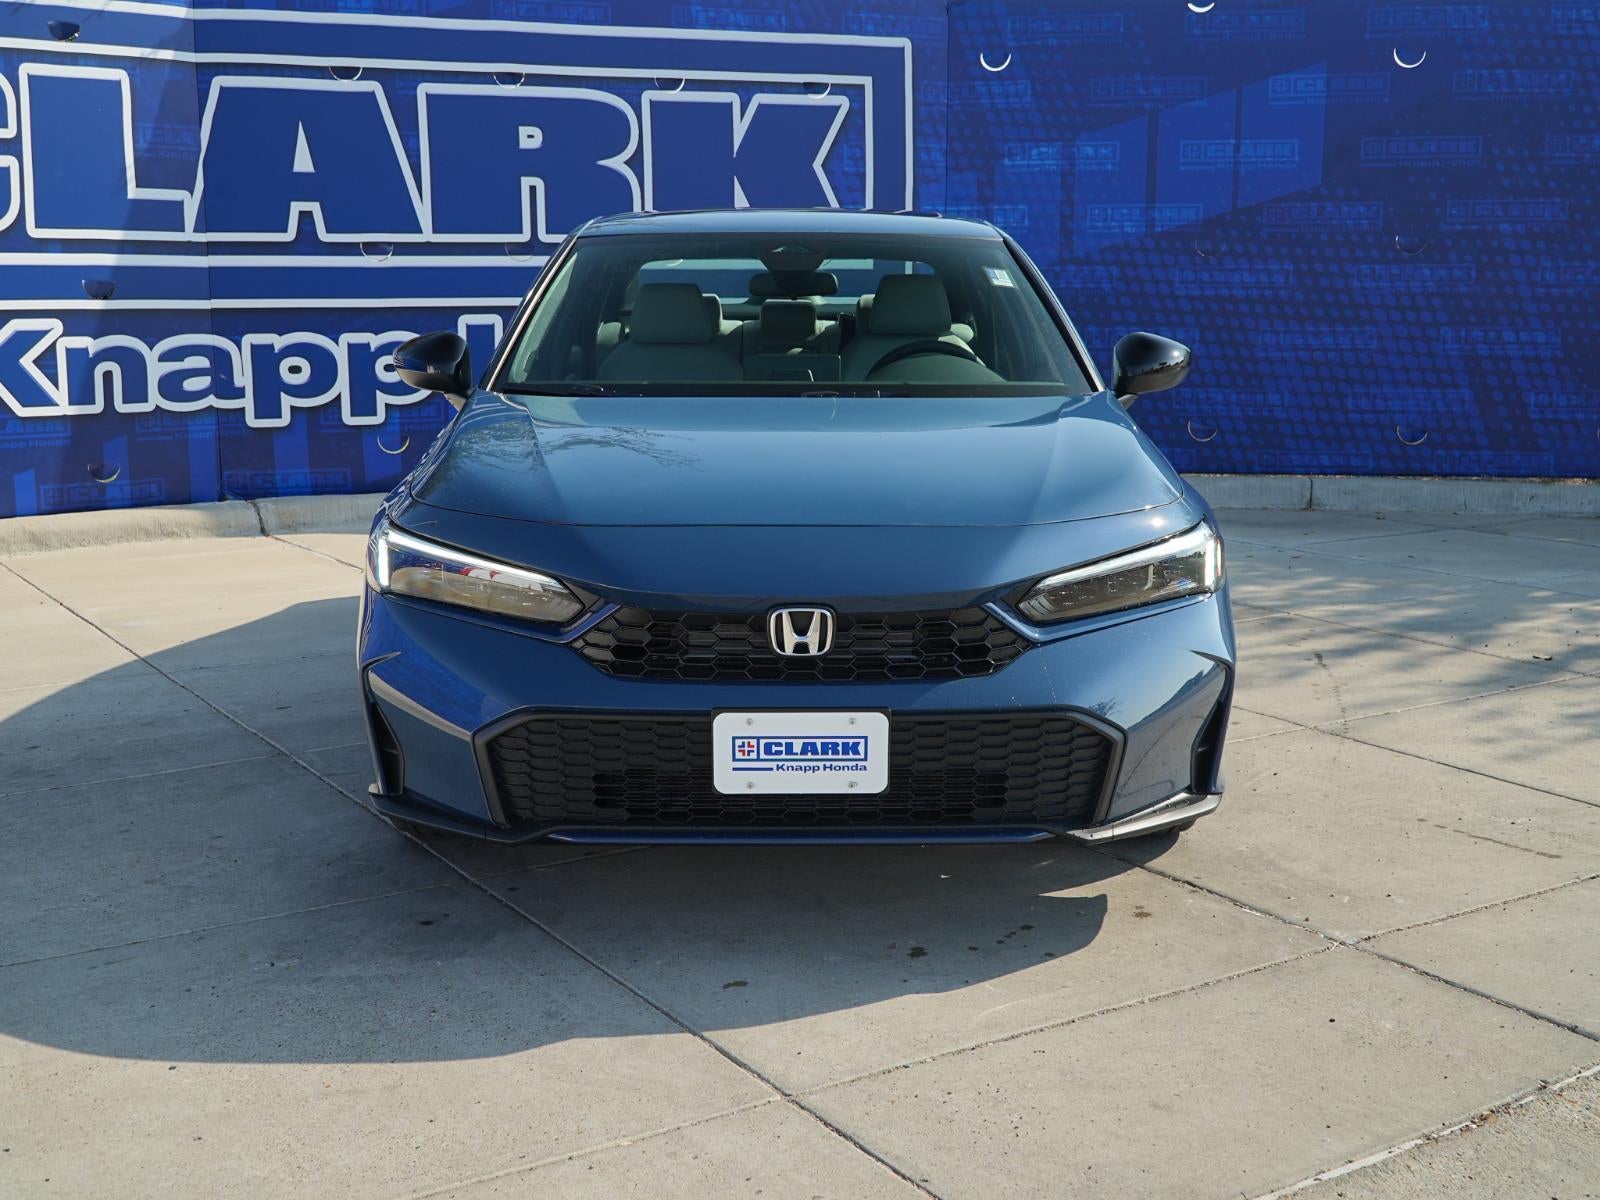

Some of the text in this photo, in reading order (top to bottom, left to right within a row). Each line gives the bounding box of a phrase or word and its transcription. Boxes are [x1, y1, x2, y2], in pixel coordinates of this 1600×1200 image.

[0, 63, 849, 243] LARK
[763, 741, 862, 757] CLARK
[776, 763, 868, 773] Knapp Honda
